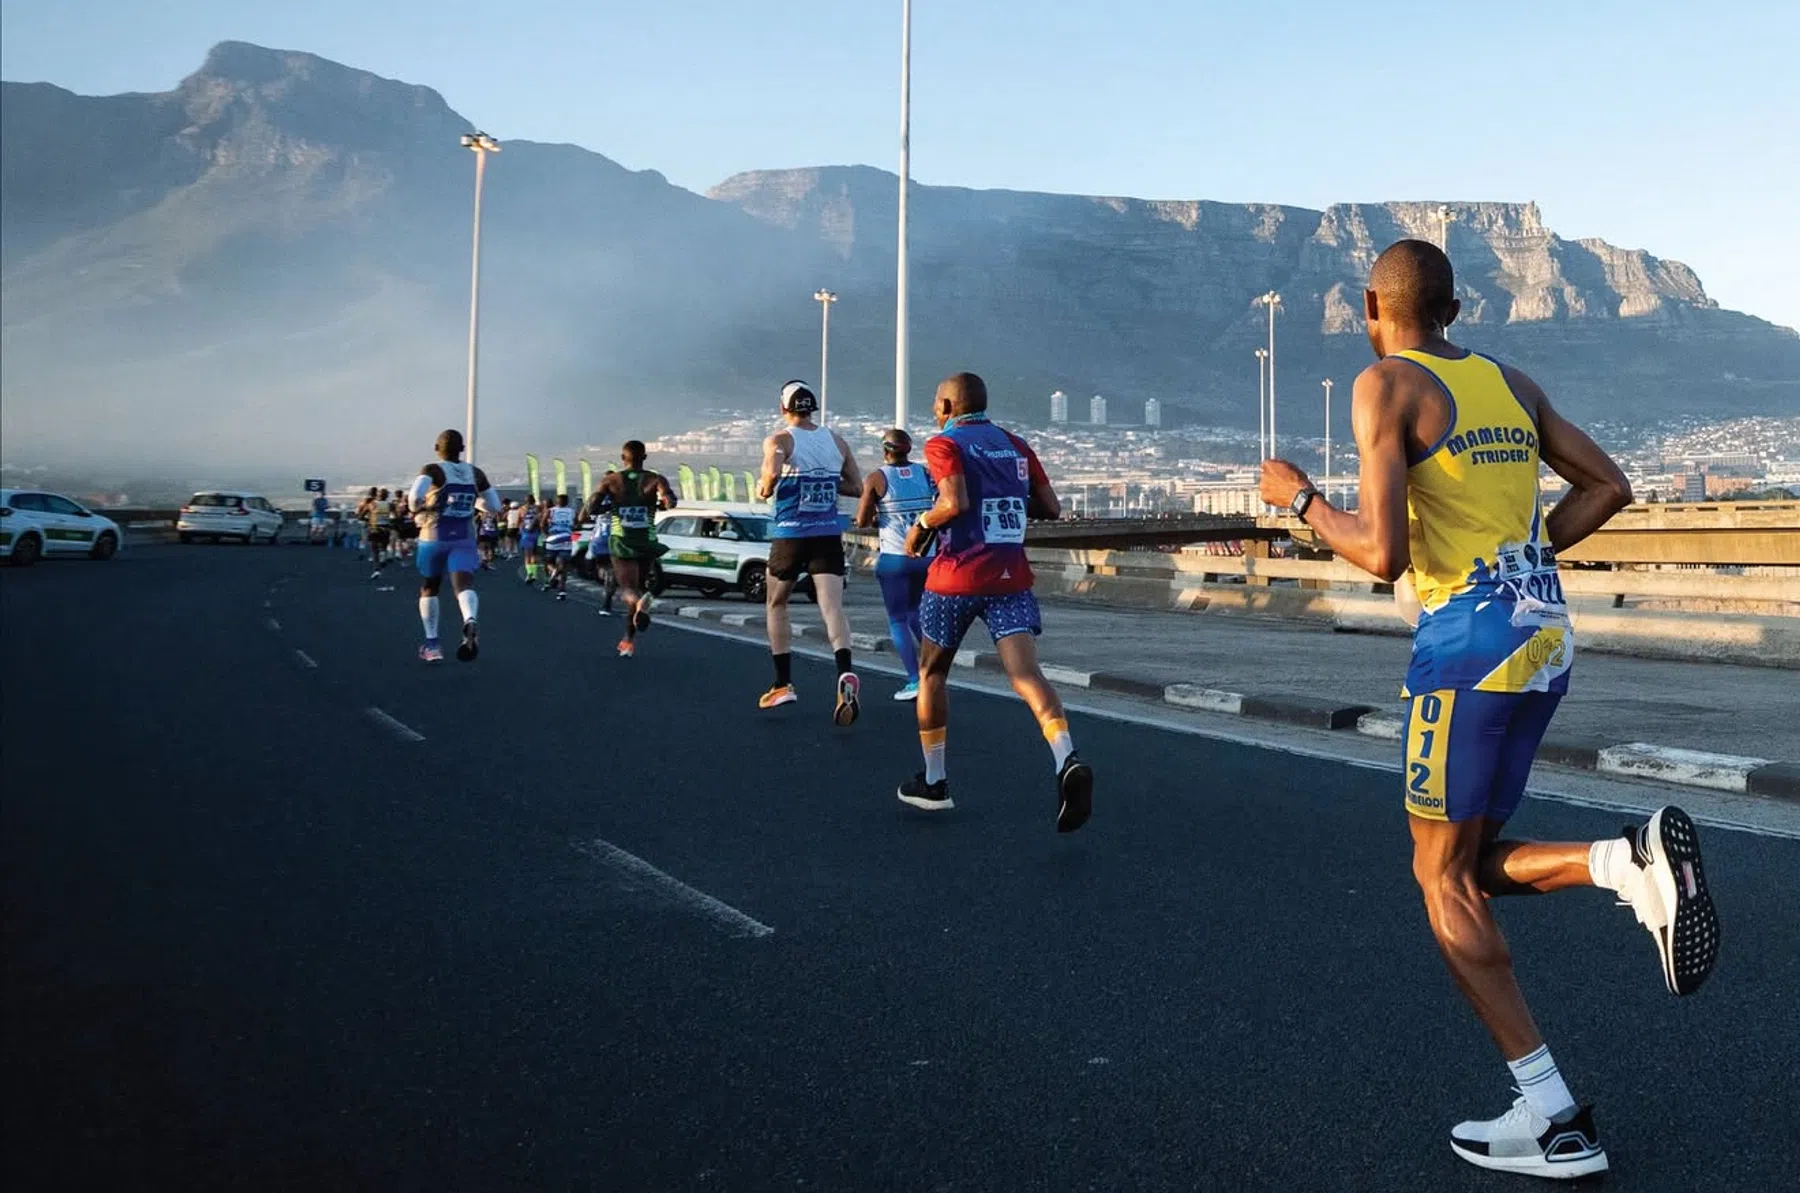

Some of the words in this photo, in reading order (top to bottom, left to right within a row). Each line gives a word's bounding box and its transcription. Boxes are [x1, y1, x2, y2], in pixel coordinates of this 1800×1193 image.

[1471, 449, 1529, 465] STRIDERS
[310, 482, 320, 490] 5
[983, 515, 991, 531] P
